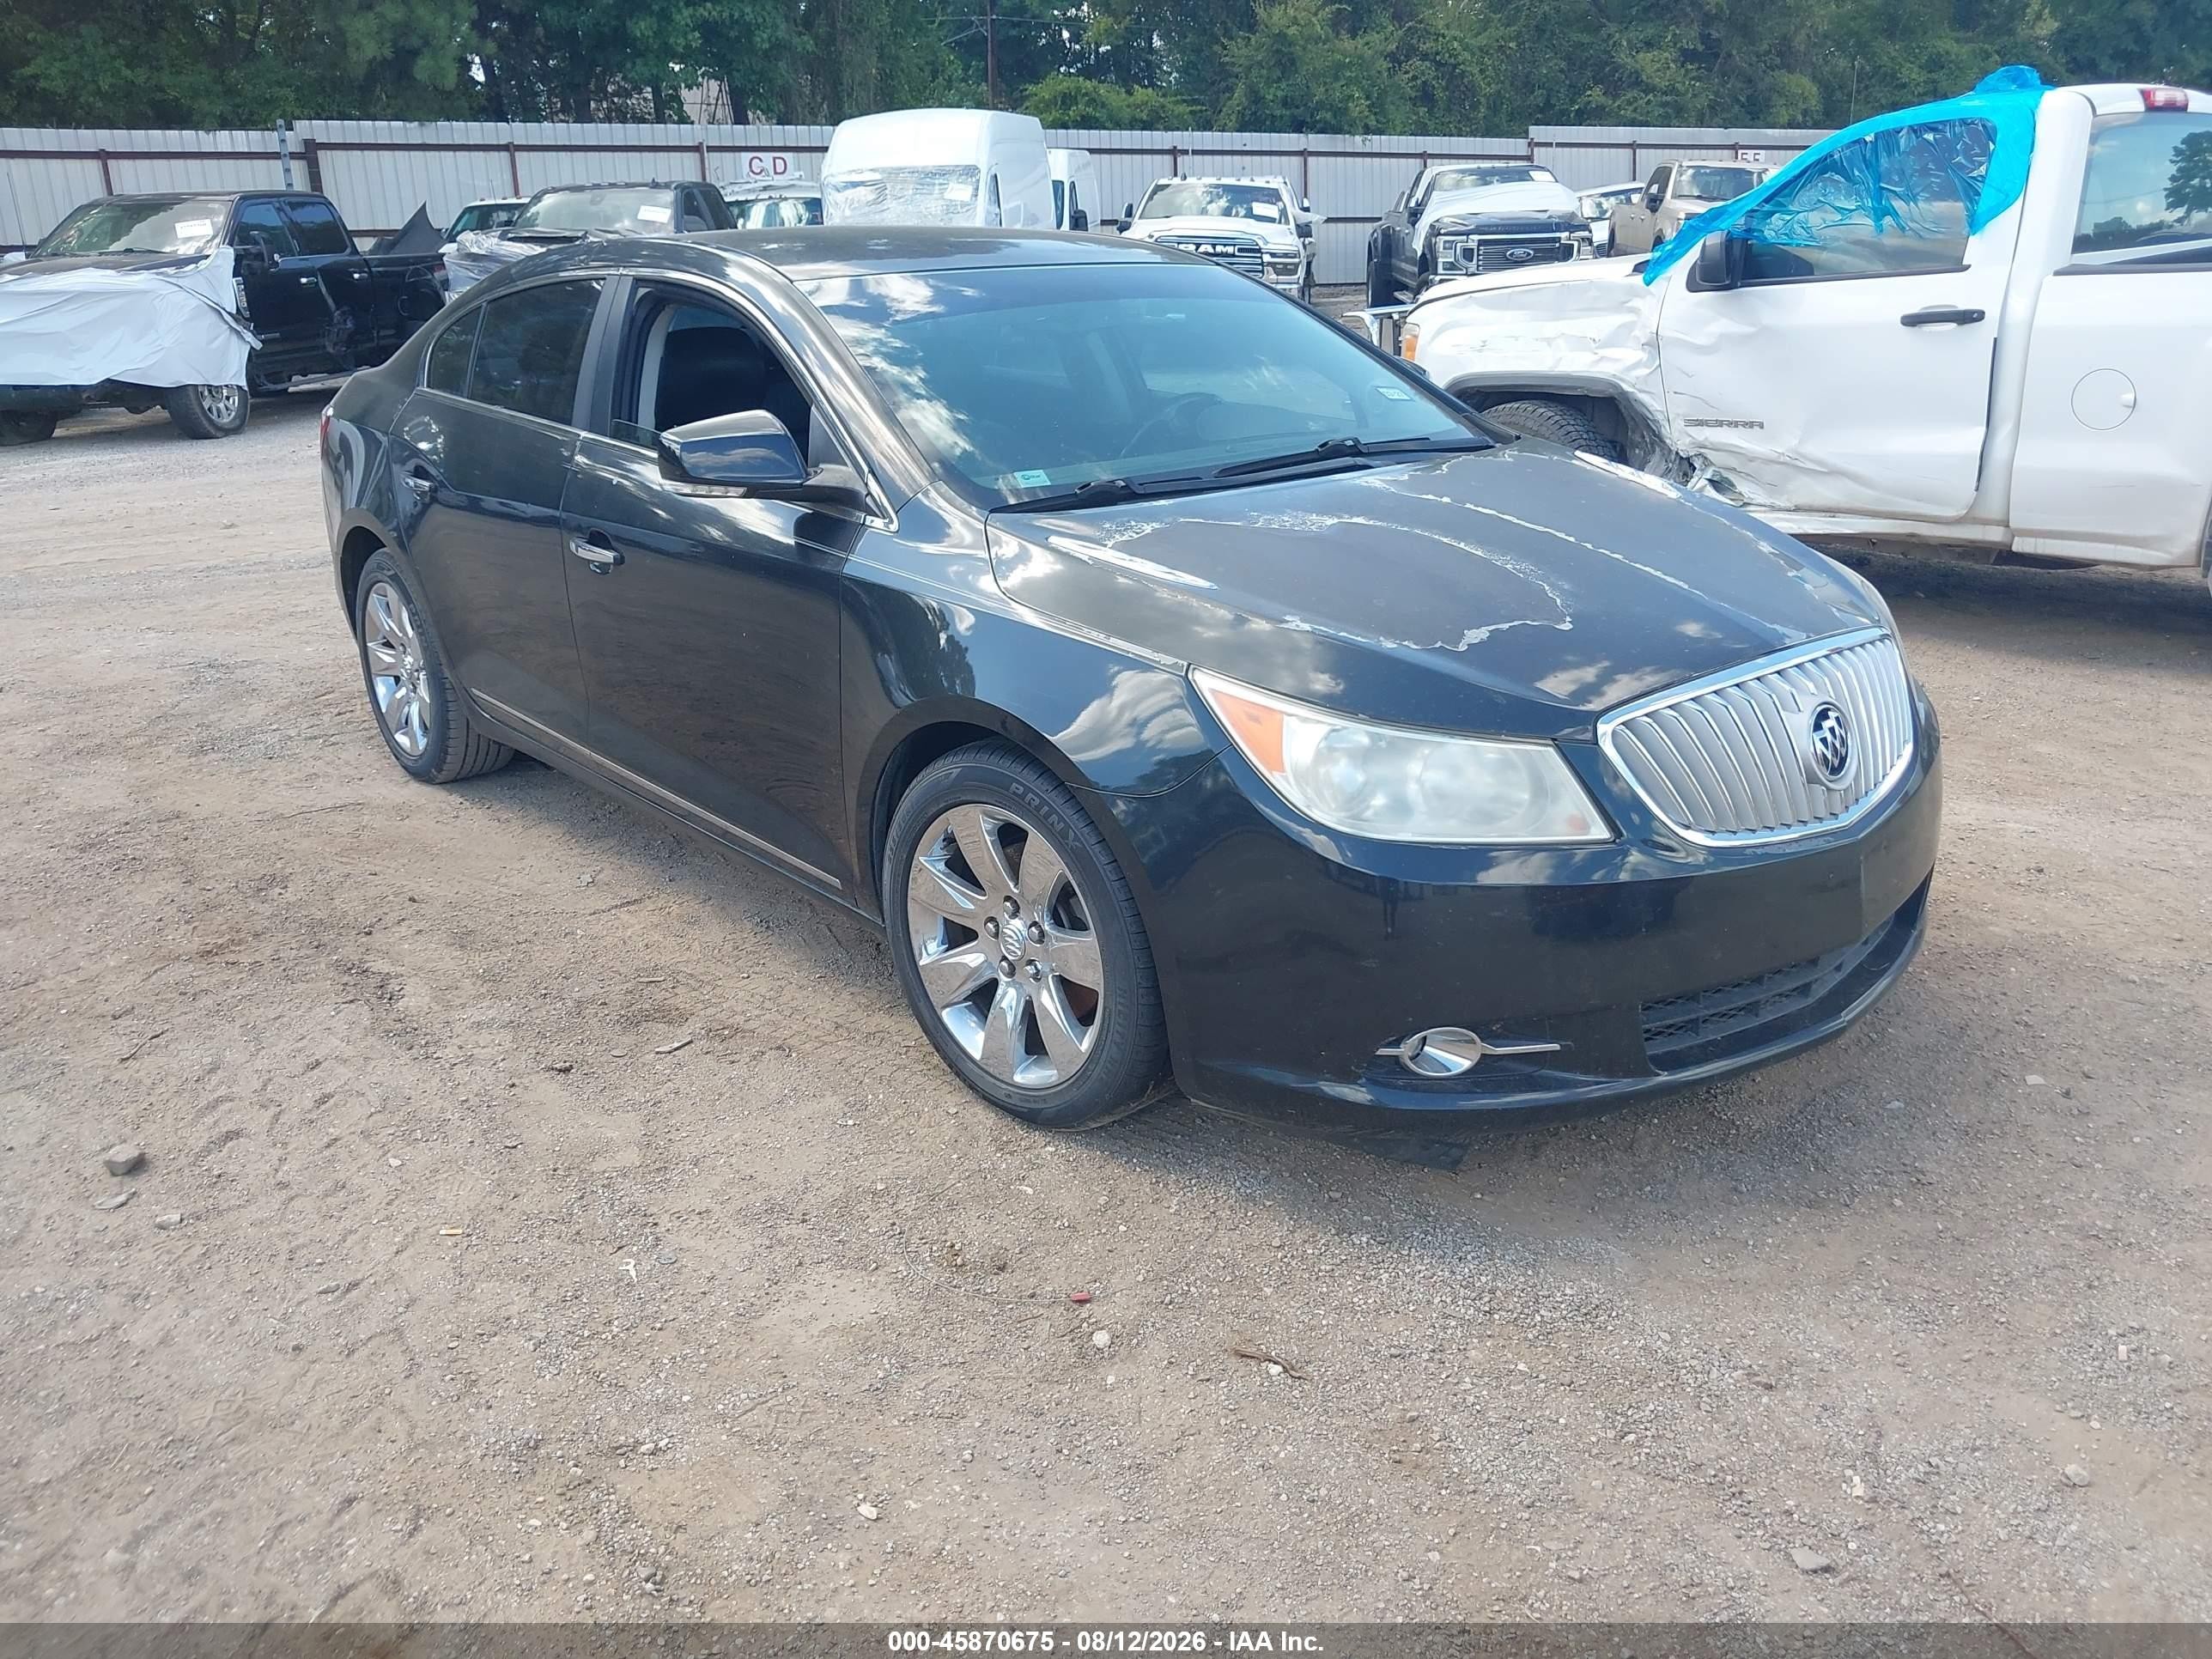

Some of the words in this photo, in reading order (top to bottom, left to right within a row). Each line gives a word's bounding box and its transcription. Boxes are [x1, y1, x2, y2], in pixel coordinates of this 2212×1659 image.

[749, 156, 763, 175] C
[773, 156, 787, 175] D
[1178, 243, 1234, 254] RAM
[1683, 418, 1765, 429] SIERRA
[1009, 782, 1084, 850] PRINX
